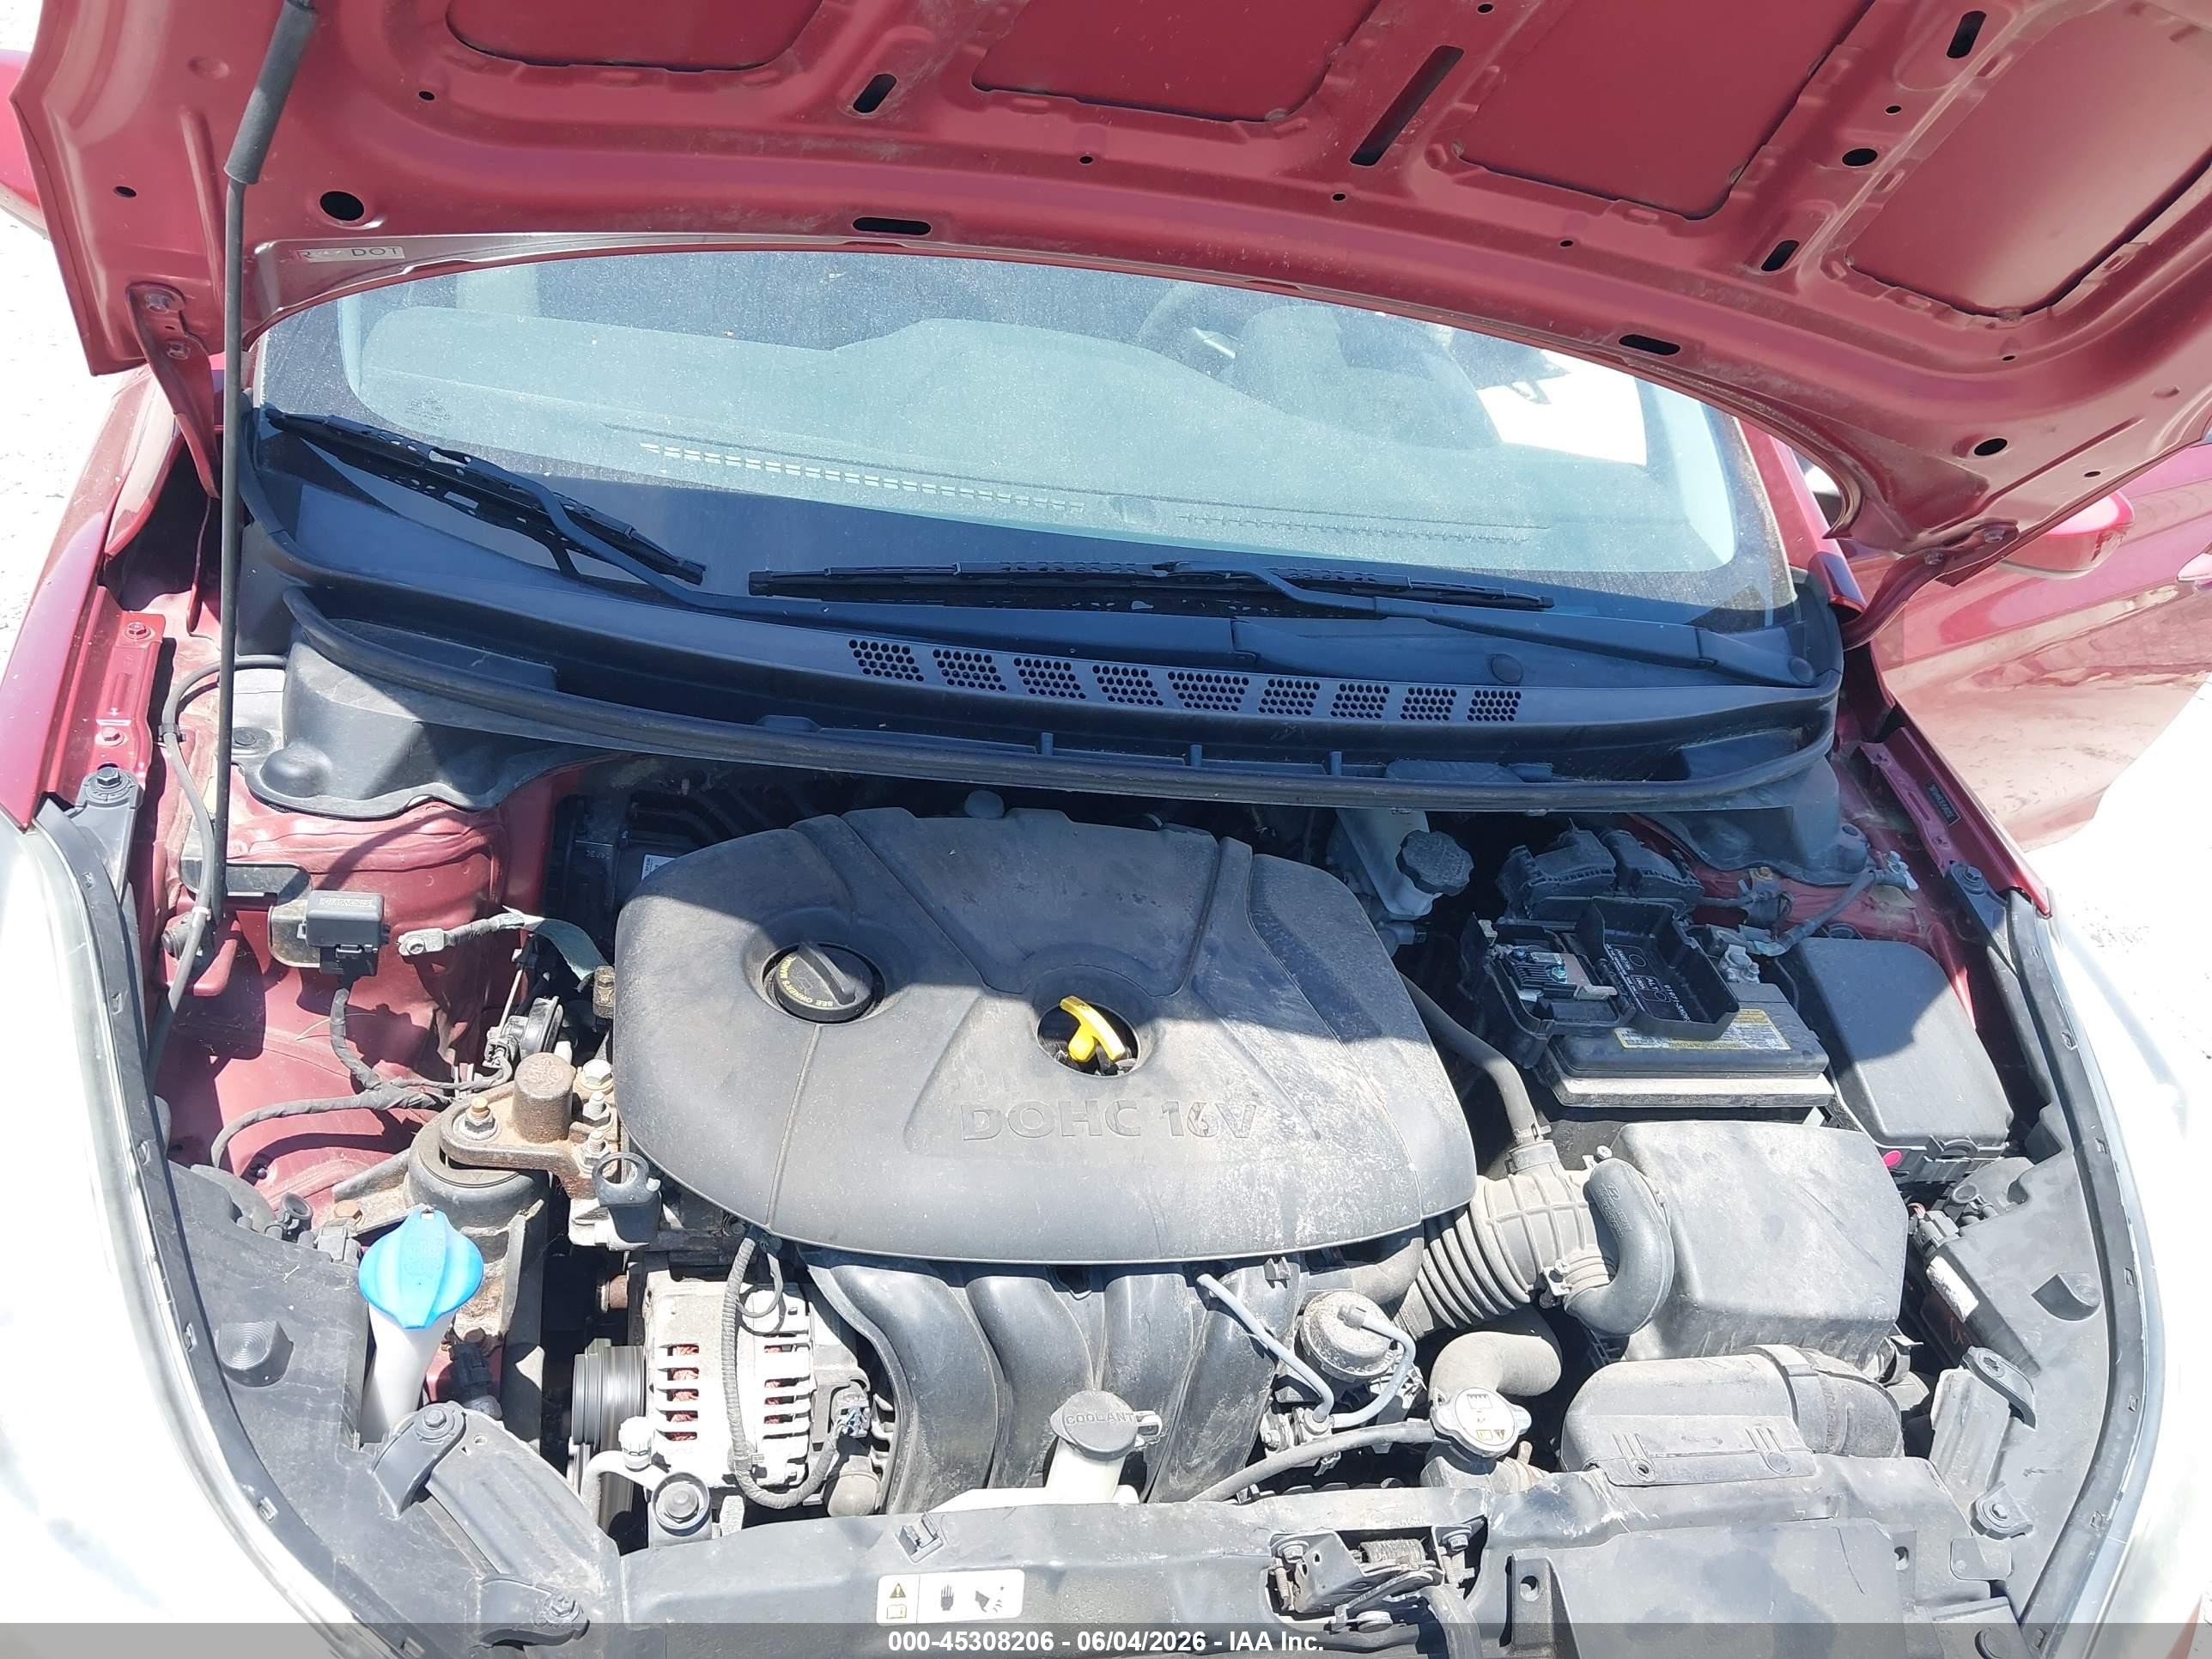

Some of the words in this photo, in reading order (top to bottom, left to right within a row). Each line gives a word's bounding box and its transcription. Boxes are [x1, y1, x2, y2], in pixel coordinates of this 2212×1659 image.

[351, 246, 398, 257] DOT
[961, 1100, 1141, 1140] DOHC
[1161, 1100, 1257, 1139] 16V
[1066, 1413, 1134, 1425] COOLANT
